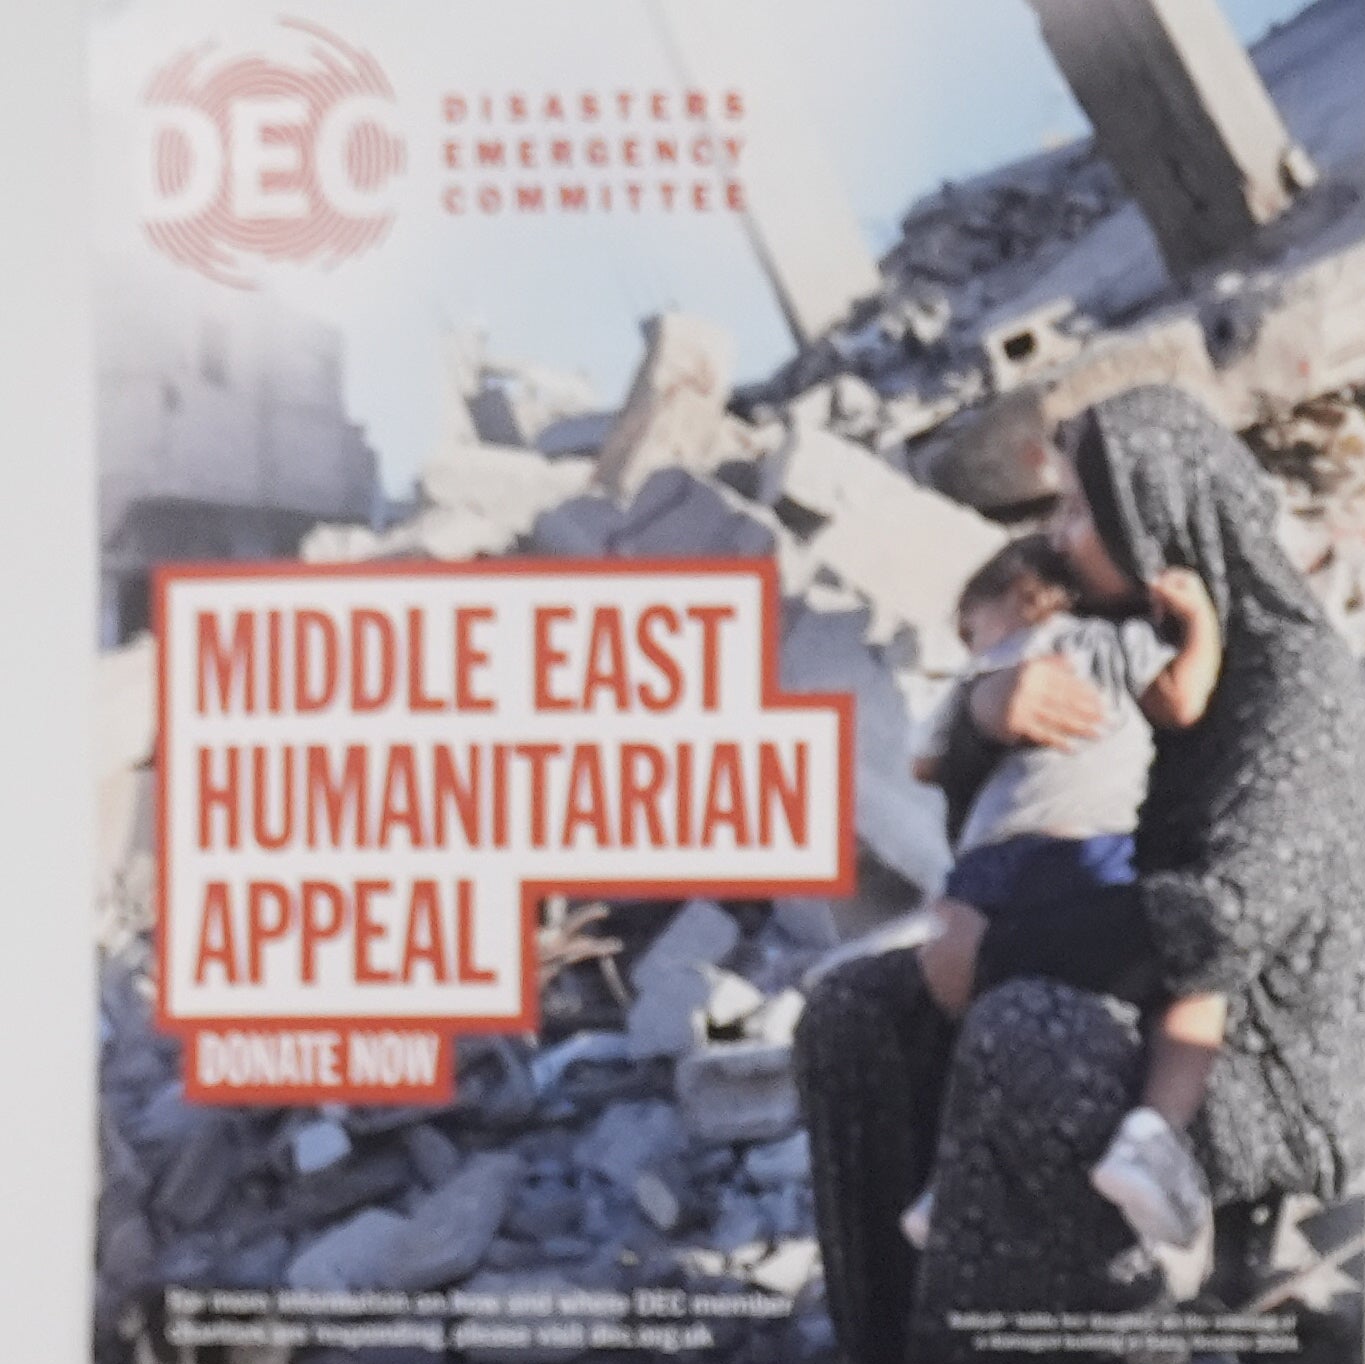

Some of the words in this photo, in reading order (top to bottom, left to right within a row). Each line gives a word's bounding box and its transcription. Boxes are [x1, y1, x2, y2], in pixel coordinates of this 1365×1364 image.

[440, 90, 746, 123] DISASTERS
[440, 138, 746, 170] EMERGENCY
[440, 182, 745, 215] COMMITTEE
[197, 607, 495, 714] MIDDLE
[533, 605, 736, 713] EAST
[197, 741, 808, 851] HUMANITARIAN
[194, 878, 495, 986] APPEAL
[199, 1030, 340, 1086] DONATE
[346, 1030, 441, 1086] NOW
